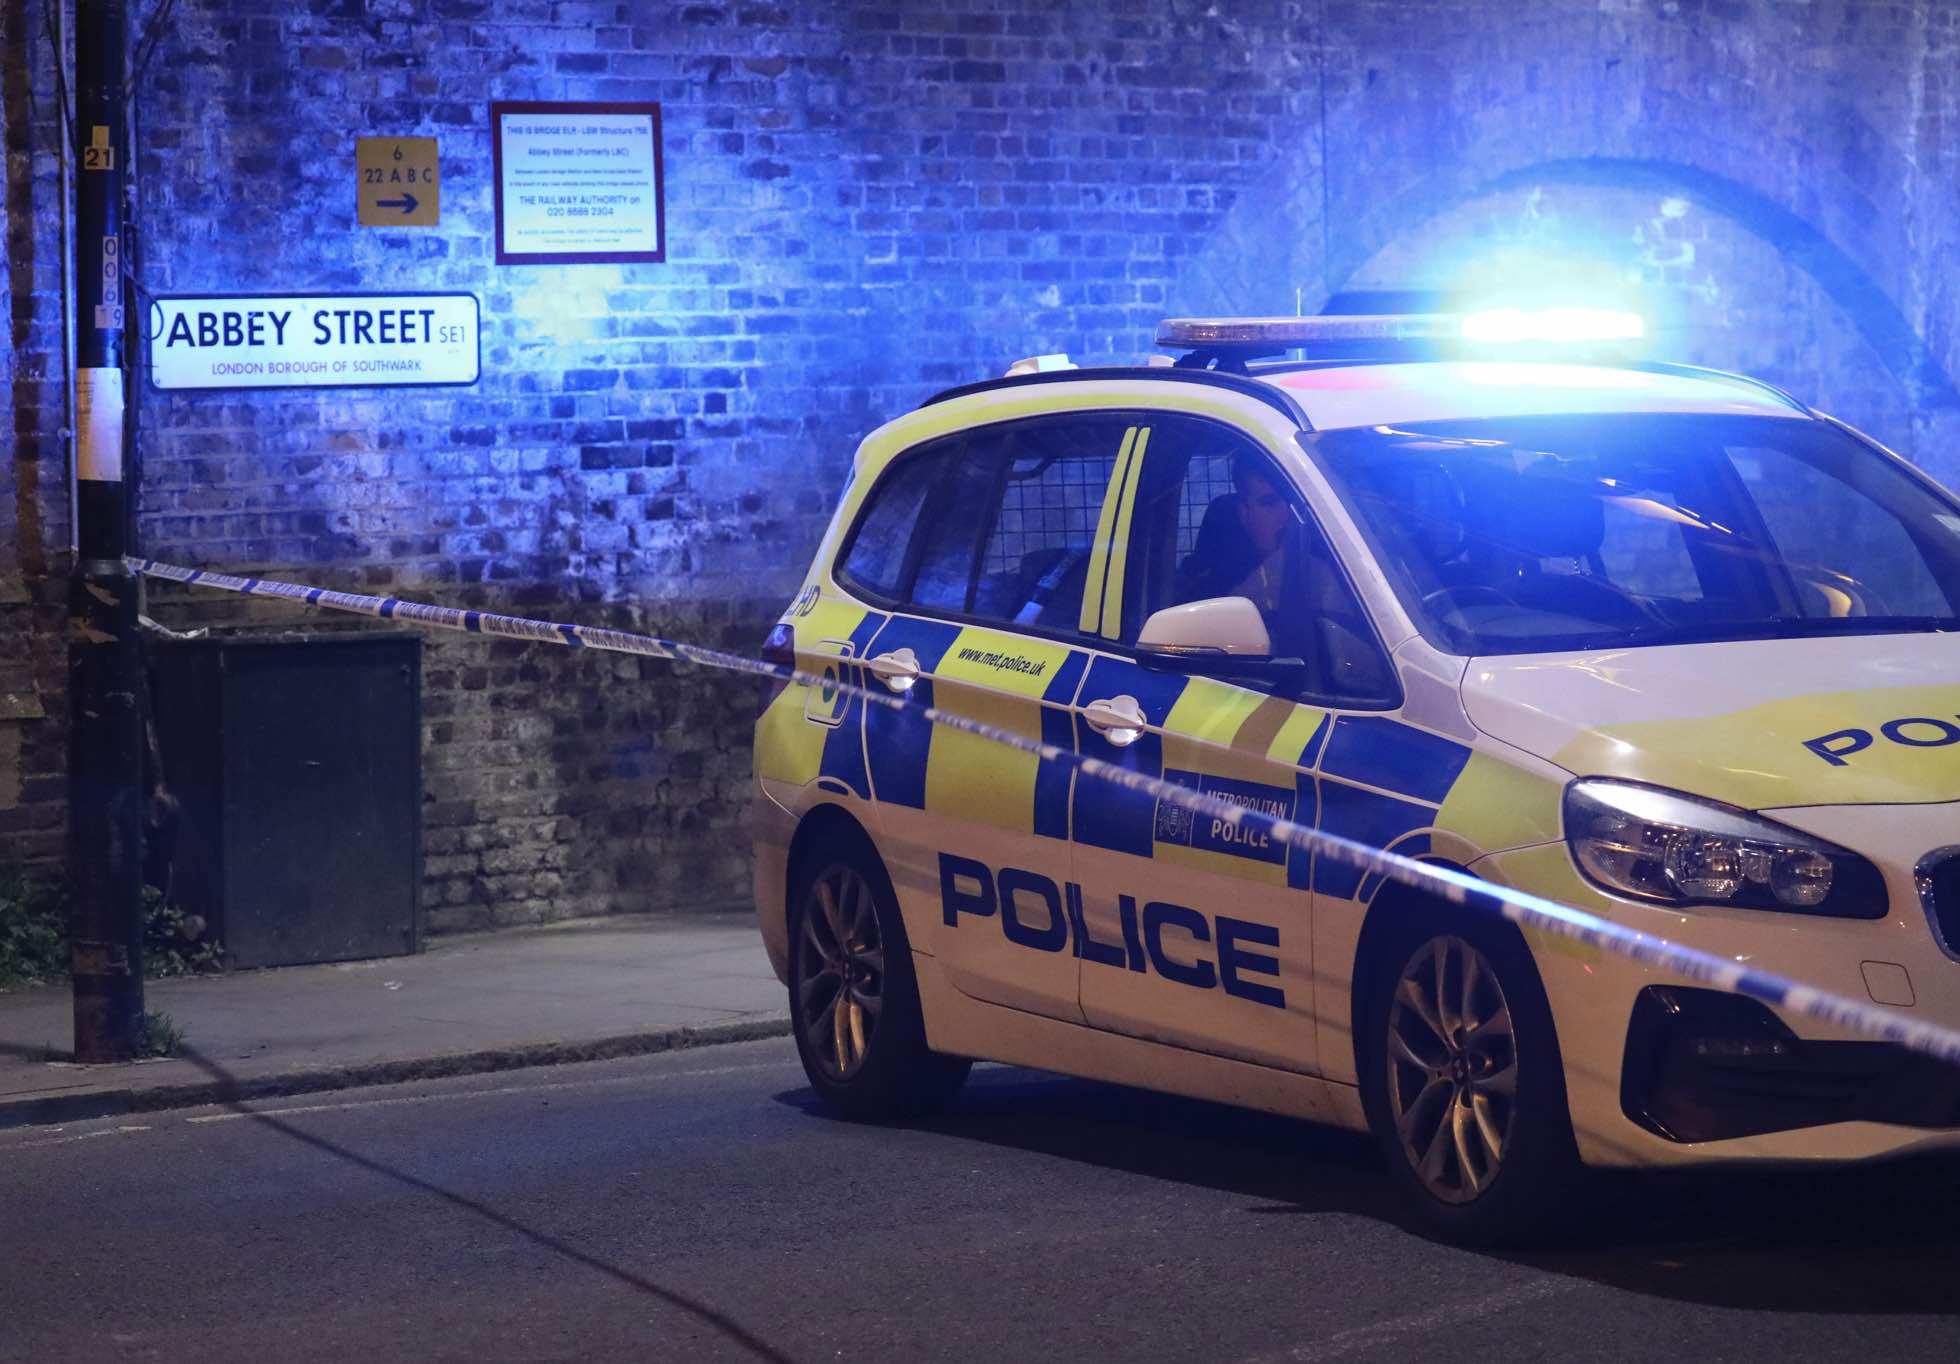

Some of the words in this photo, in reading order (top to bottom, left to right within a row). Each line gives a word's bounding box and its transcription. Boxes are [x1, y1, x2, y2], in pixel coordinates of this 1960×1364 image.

[86, 149, 110, 167] 21
[393, 144, 402, 161] 6
[365, 167, 384, 184] 22
[390, 167, 401, 184] A
[407, 167, 417, 184] B
[422, 167, 433, 184] C
[520, 195, 536, 205] THE
[538, 195, 577, 205] RAILWAY
[580, 195, 627, 205] AUTHORITY
[166, 311, 292, 347] ABBEY
[313, 309, 435, 345] STREET
[439, 326, 465, 343] SE1
[212, 362, 263, 375] LONDON
[268, 361, 327, 374] BOROUGH
[332, 361, 347, 373] OF
[352, 359, 422, 373] SOUTHWARK
[959, 647, 1047, 677] www.met.police.uk
[1801, 714, 1960, 767] PO
[1211, 819, 1269, 849] POLICE
[938, 852, 1286, 1009] POLICE
